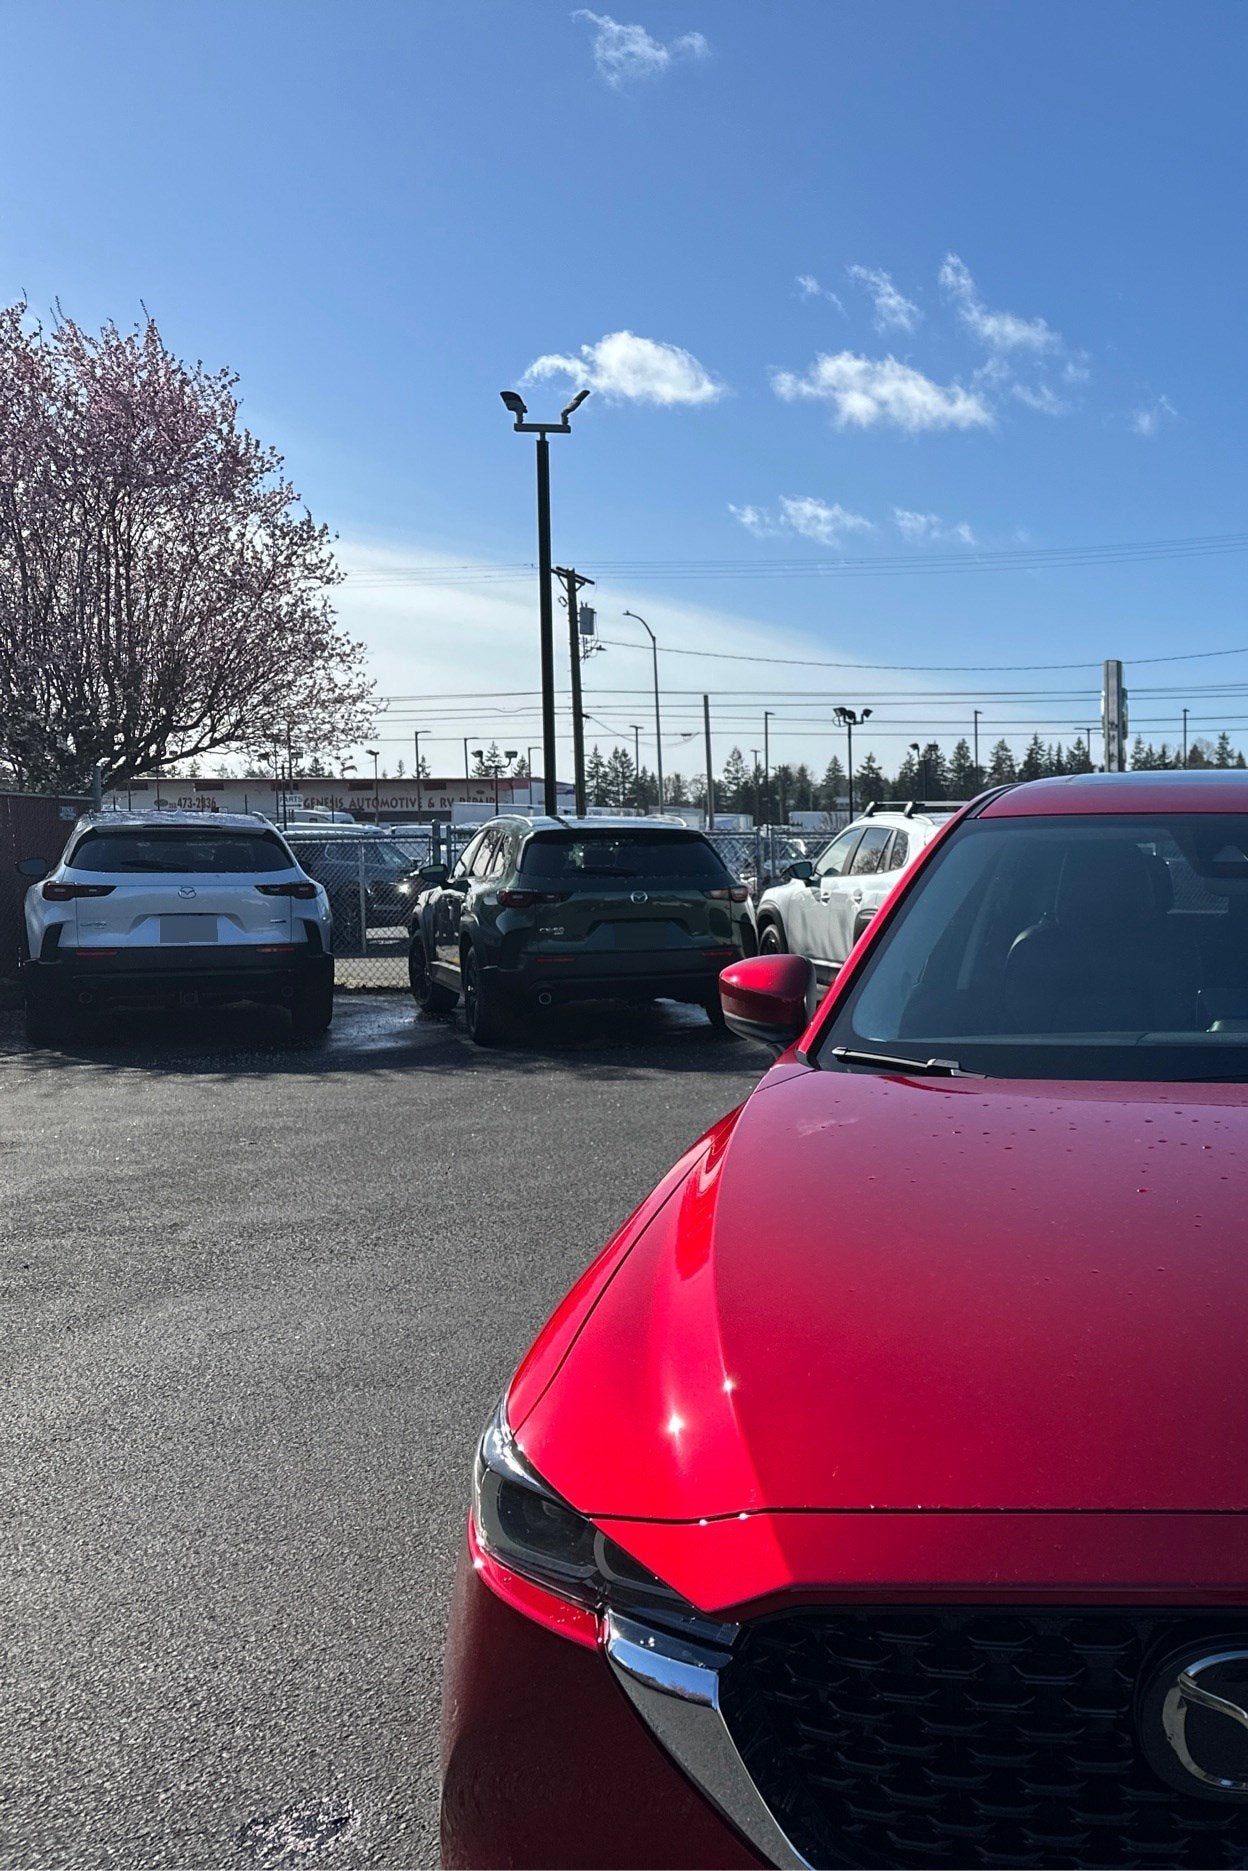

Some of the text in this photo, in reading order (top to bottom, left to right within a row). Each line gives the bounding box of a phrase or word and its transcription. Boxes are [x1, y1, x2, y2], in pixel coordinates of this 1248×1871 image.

[280, 795, 303, 803] PARTS
[349, 796, 422, 809] AUTOMOTIVE
[427, 796, 435, 808] &
[440, 797, 454, 808] RV
